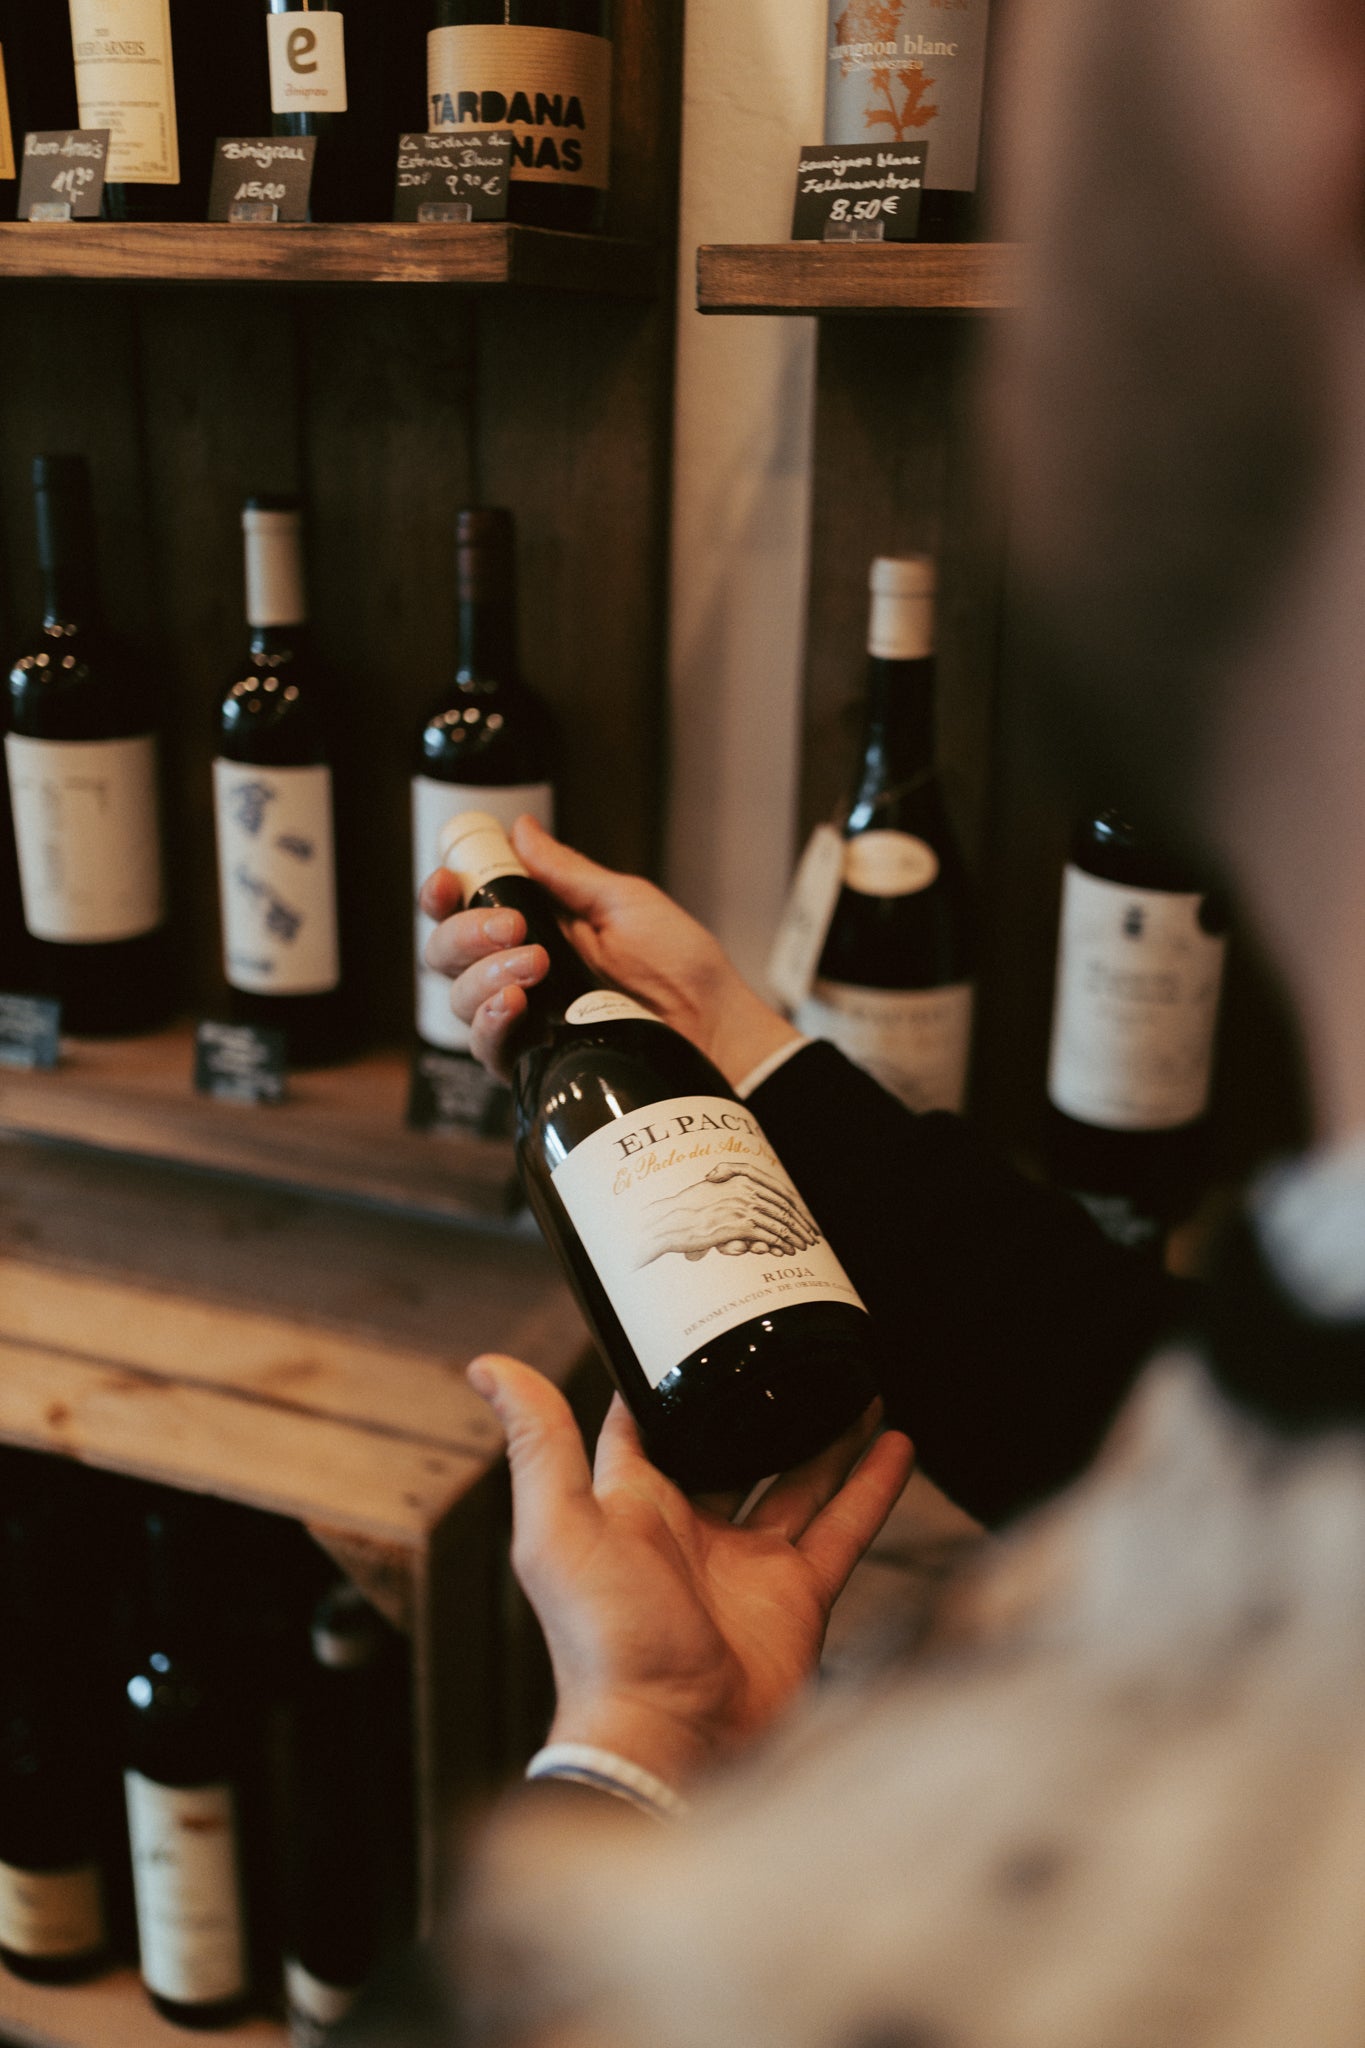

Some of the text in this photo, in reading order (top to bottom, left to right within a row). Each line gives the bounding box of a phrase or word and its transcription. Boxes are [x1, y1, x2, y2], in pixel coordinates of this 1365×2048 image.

[903, 33, 960, 57] blanc
[431, 90, 586, 131] TARDANA
[612, 1122, 671, 1161] EL
[688, 1142, 712, 1160] del
[761, 1266, 816, 1284] RIOJA
